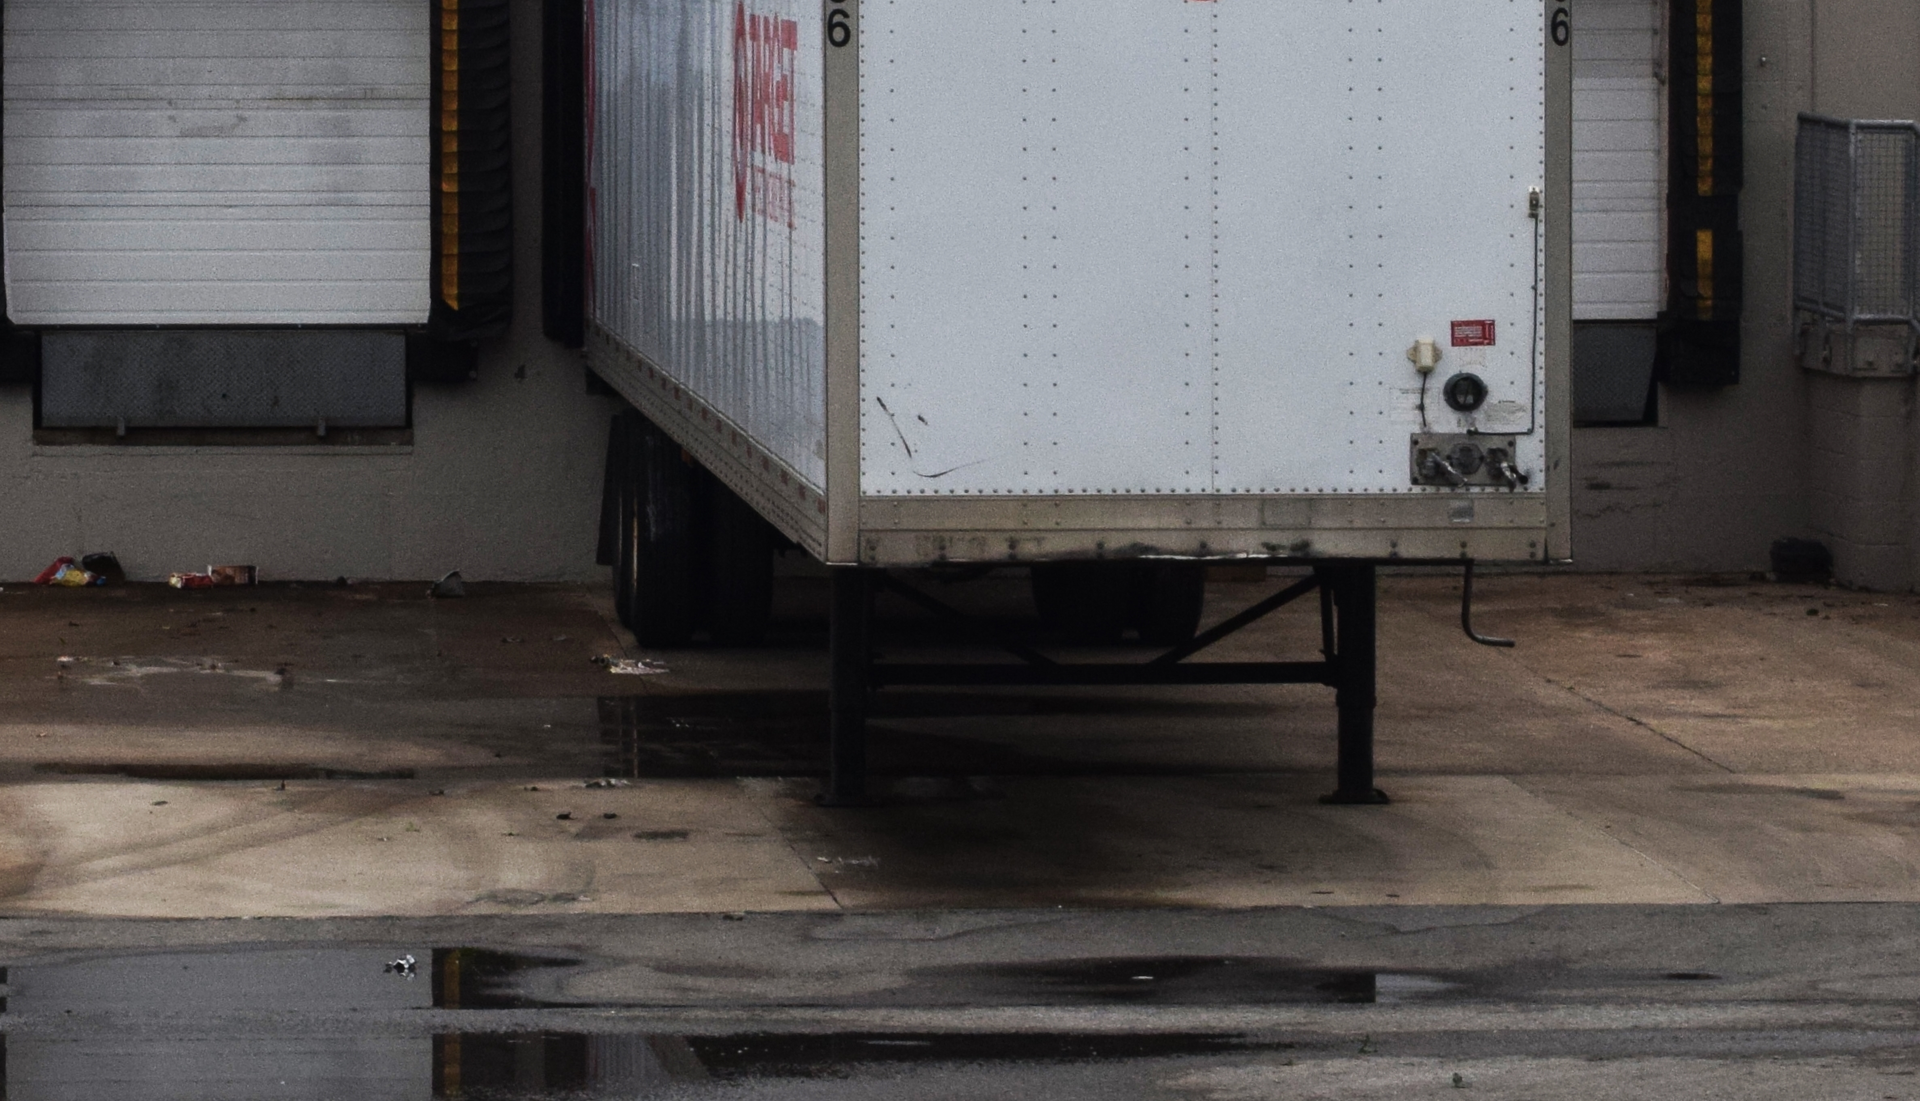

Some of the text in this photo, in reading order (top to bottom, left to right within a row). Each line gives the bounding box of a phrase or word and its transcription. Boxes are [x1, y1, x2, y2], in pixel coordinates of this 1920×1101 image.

[827, 0, 851, 48] 6
[1551, 0, 1569, 47] 6
[749, 13, 798, 165] TARGET
